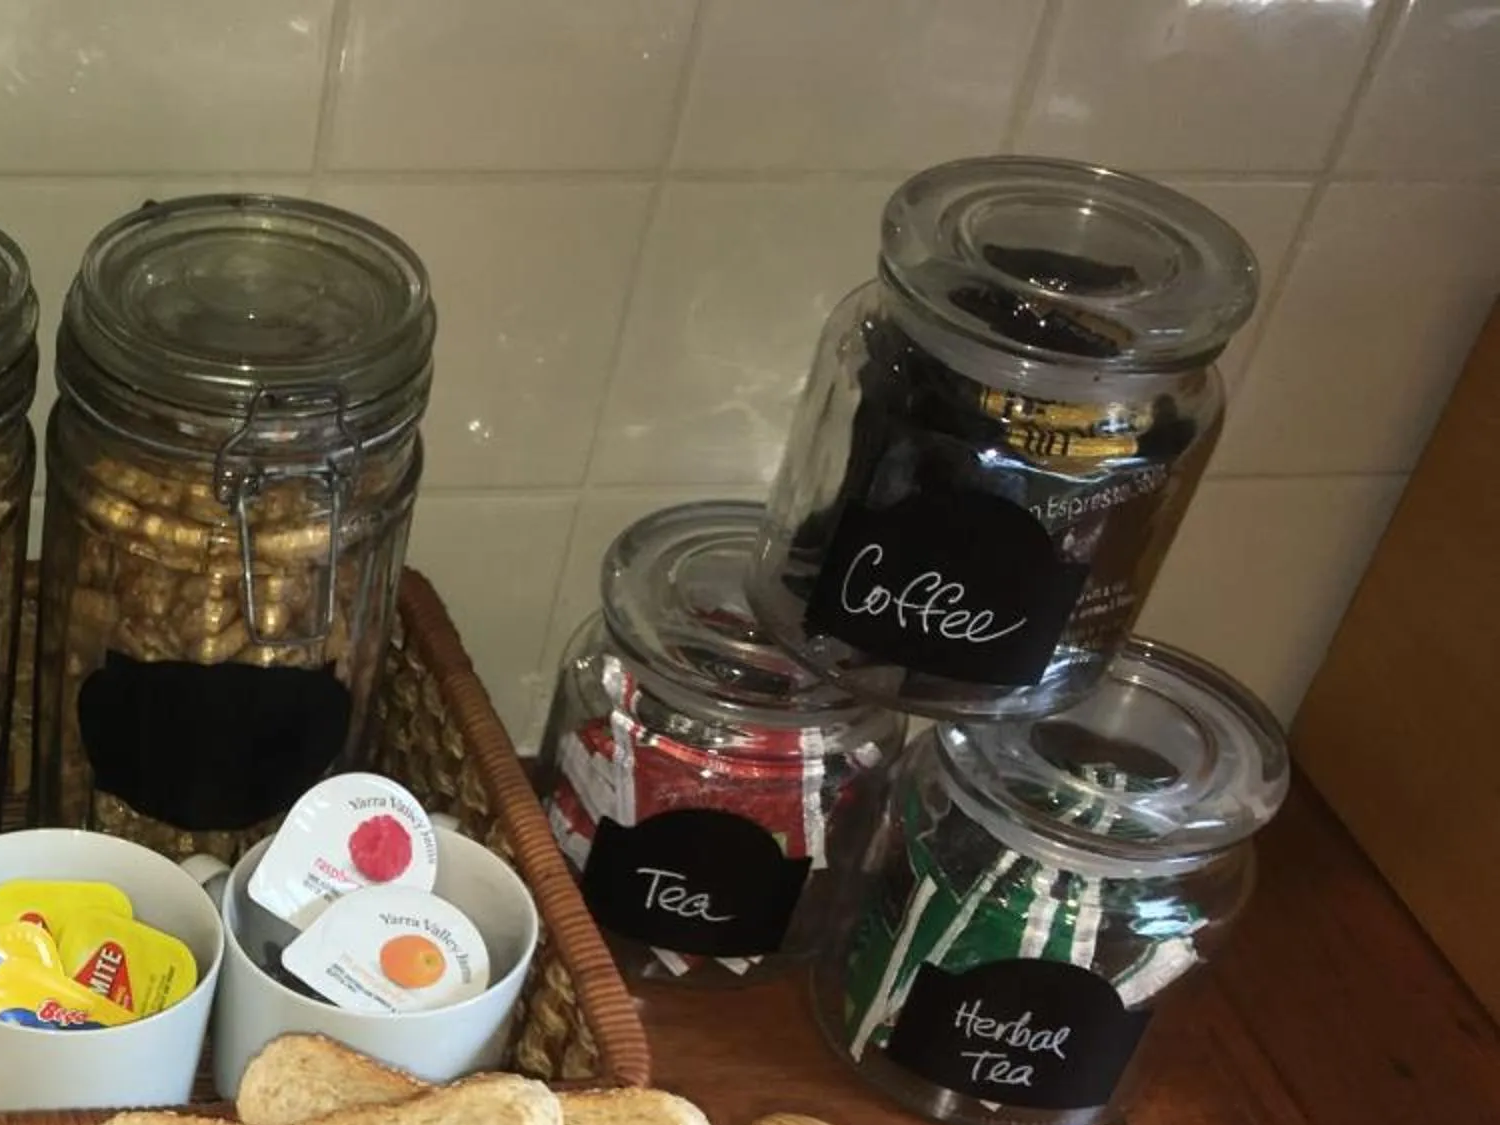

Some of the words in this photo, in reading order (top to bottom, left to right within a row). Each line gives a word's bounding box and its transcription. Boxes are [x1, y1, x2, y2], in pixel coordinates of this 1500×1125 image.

[840, 543, 1027, 643] Coffee
[348, 796, 387, 811] Yarra
[636, 867, 736, 922] Tea
[379, 912, 420, 928] Yarra
[424, 919, 458, 953] Valley
[955, 1000, 1071, 1059] Herbal
[961, 1050, 1036, 1086] Tea
